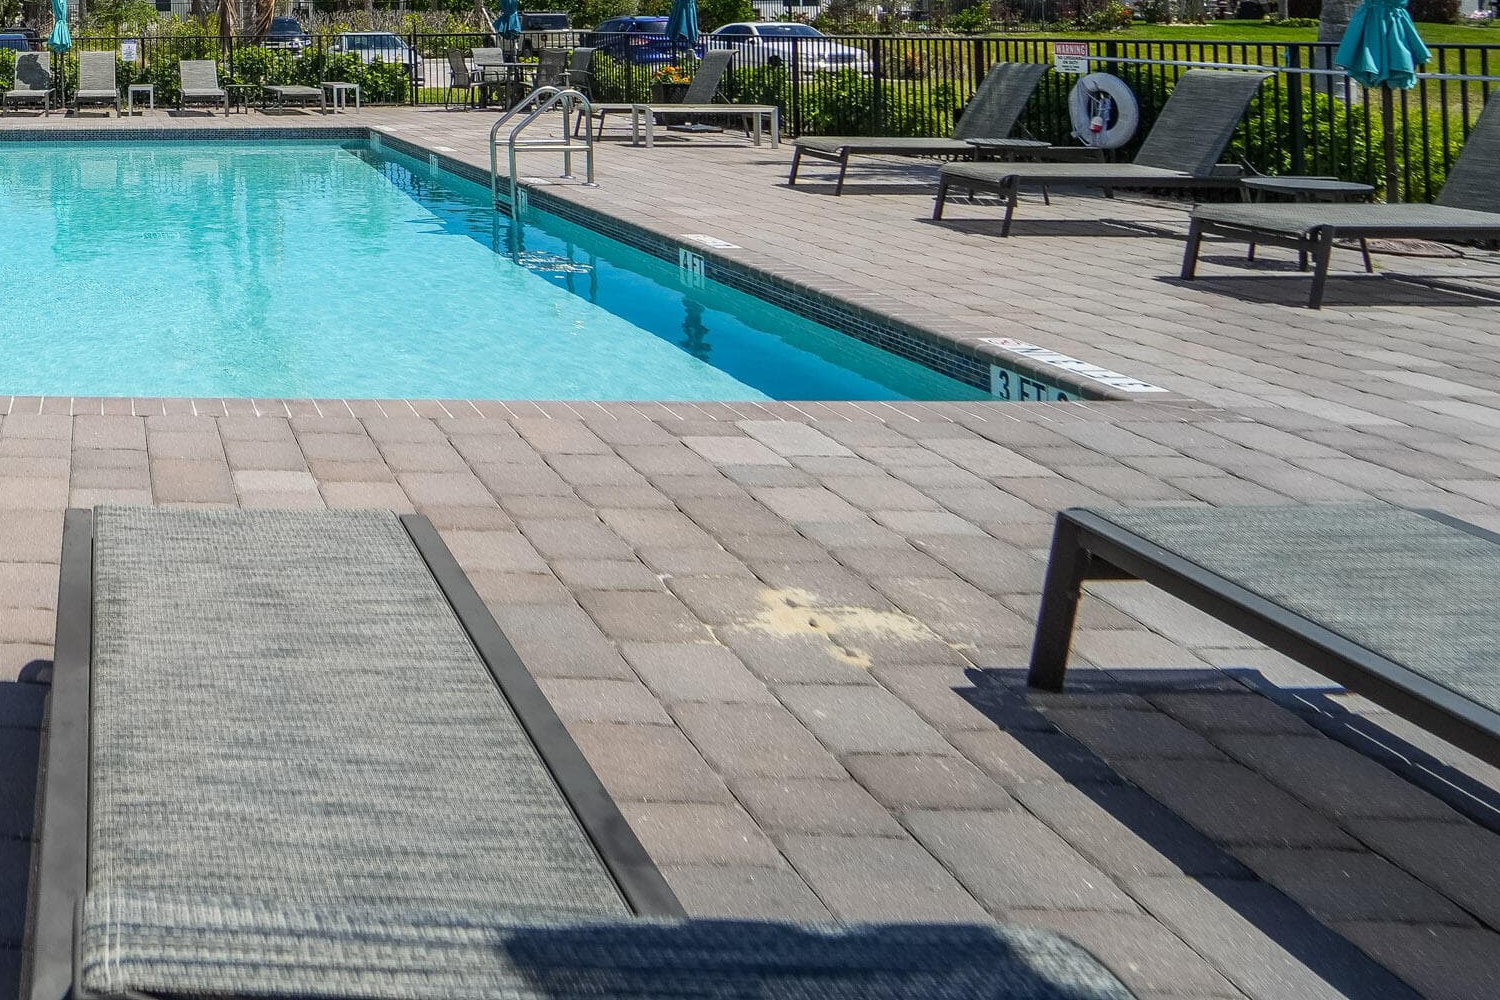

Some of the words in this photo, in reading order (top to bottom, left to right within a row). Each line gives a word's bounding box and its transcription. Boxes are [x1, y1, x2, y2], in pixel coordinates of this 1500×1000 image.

[1056, 44, 1086, 55] WARNING
[692, 254, 704, 275] FT
[999, 369, 1010, 400] 3
[1020, 376, 1047, 401] FT
